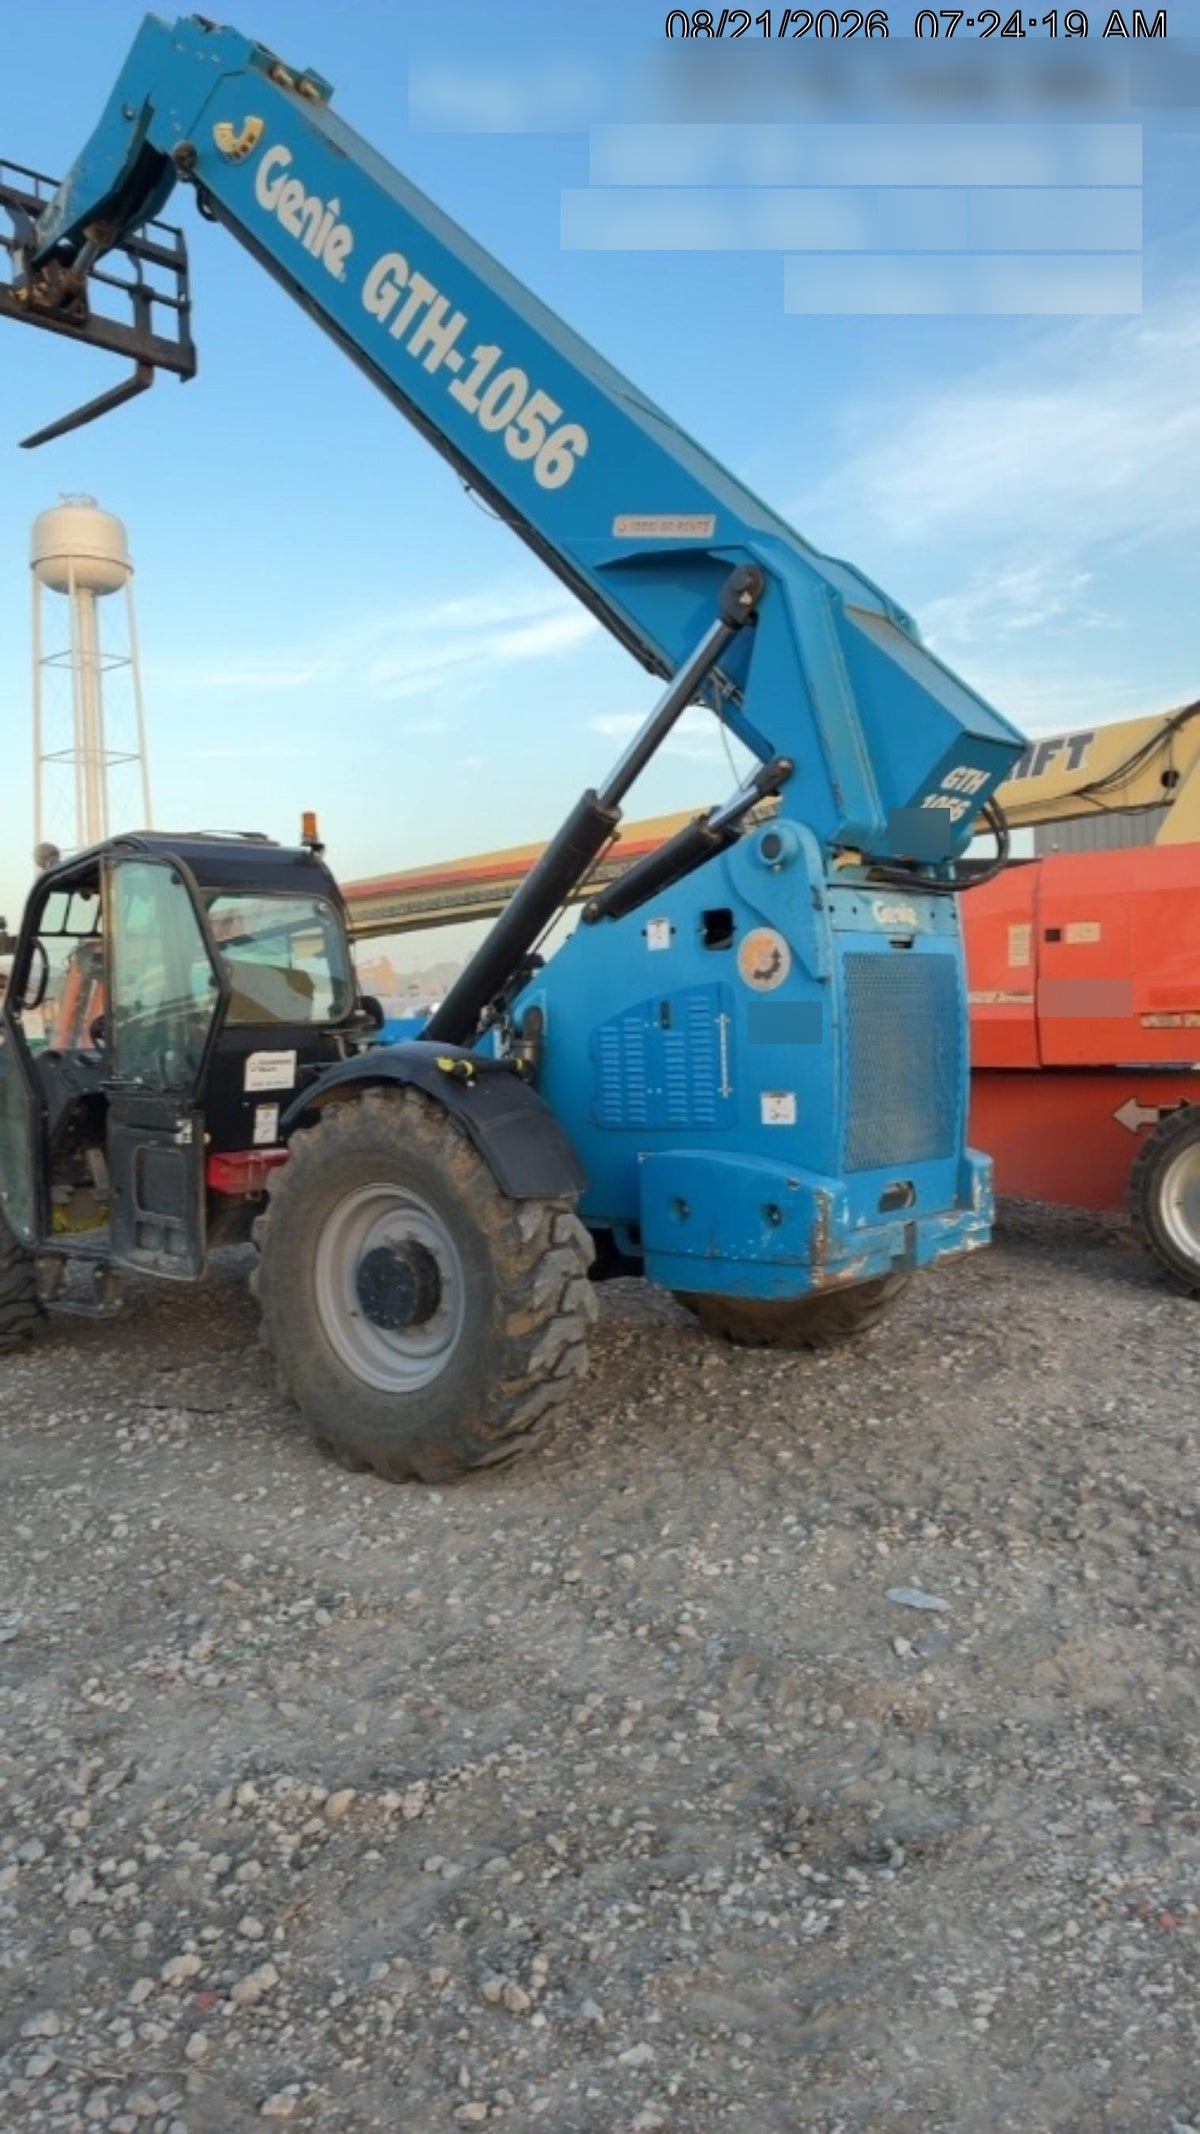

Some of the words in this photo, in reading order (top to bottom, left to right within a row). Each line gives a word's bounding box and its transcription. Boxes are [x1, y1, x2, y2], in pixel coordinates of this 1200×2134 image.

[255, 144, 354, 279] Genie
[361, 252, 589, 489] GTH-1056
[1008, 731, 1096, 780] IFT
[940, 766, 992, 795] GTH
